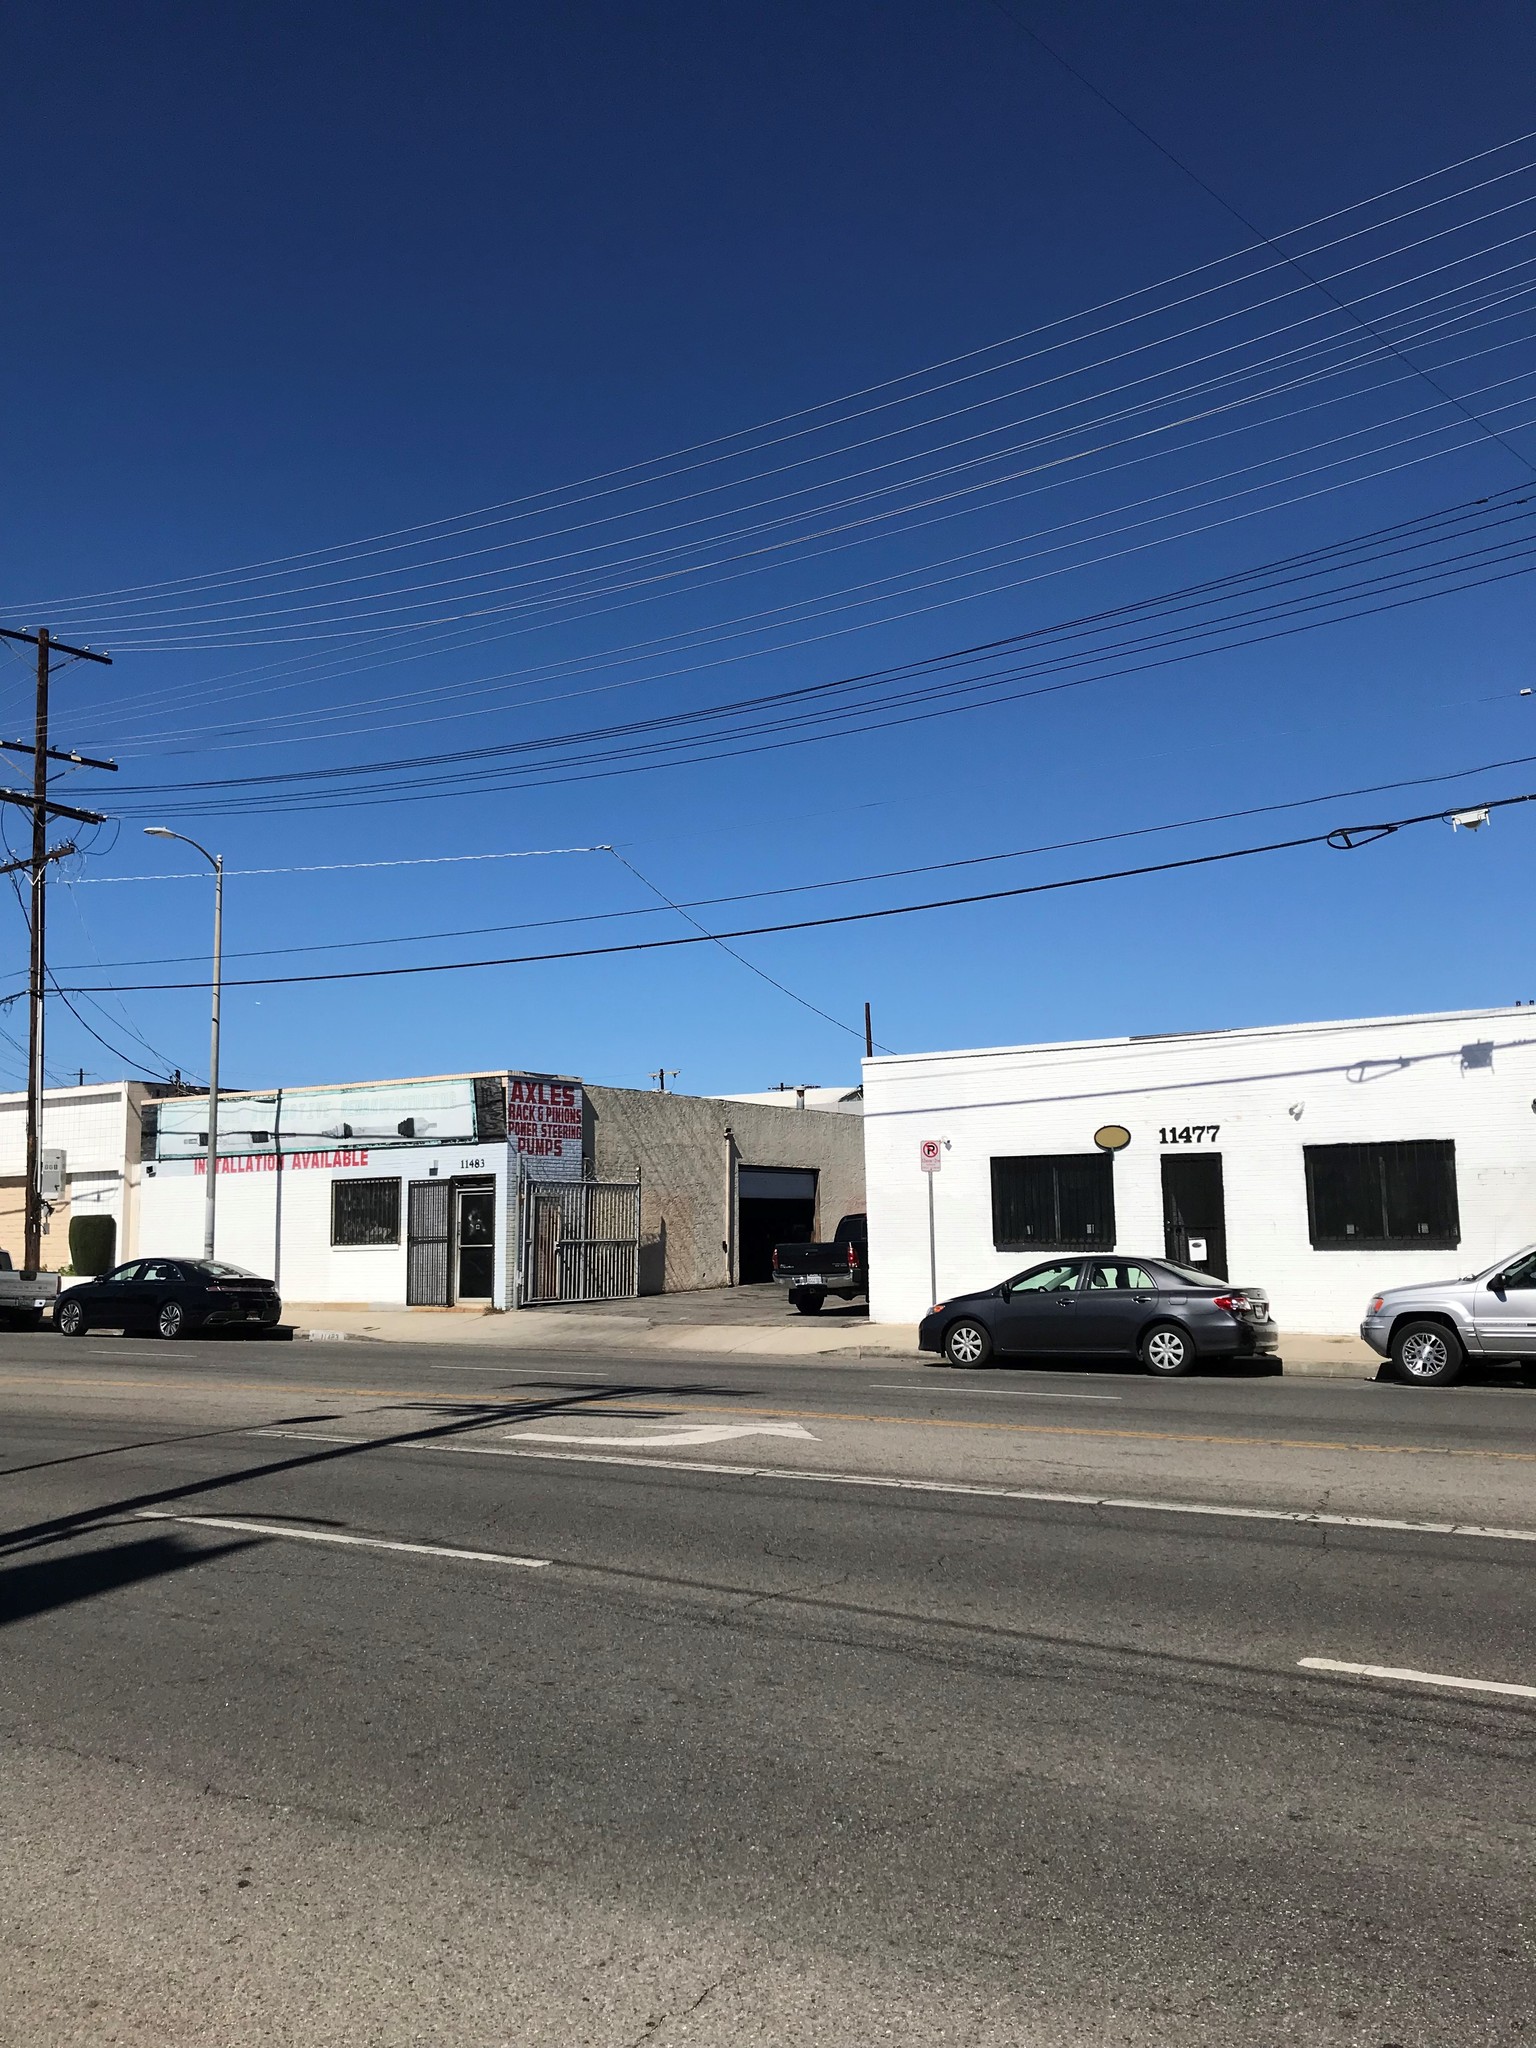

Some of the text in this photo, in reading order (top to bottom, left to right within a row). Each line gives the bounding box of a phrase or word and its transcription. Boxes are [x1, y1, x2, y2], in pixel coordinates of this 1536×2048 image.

[511, 1081, 575, 1106] AXLES
[509, 1104, 535, 1121] RACK
[546, 1107, 582, 1124] PINIONS
[508, 1122, 582, 1139] POWER STEERING
[1159, 1125, 1221, 1144] 11477
[518, 1138, 563, 1157] PUMPS
[194, 1150, 368, 1175] INTALLATION AVAILABLE
[461, 1159, 485, 1168] 11483
